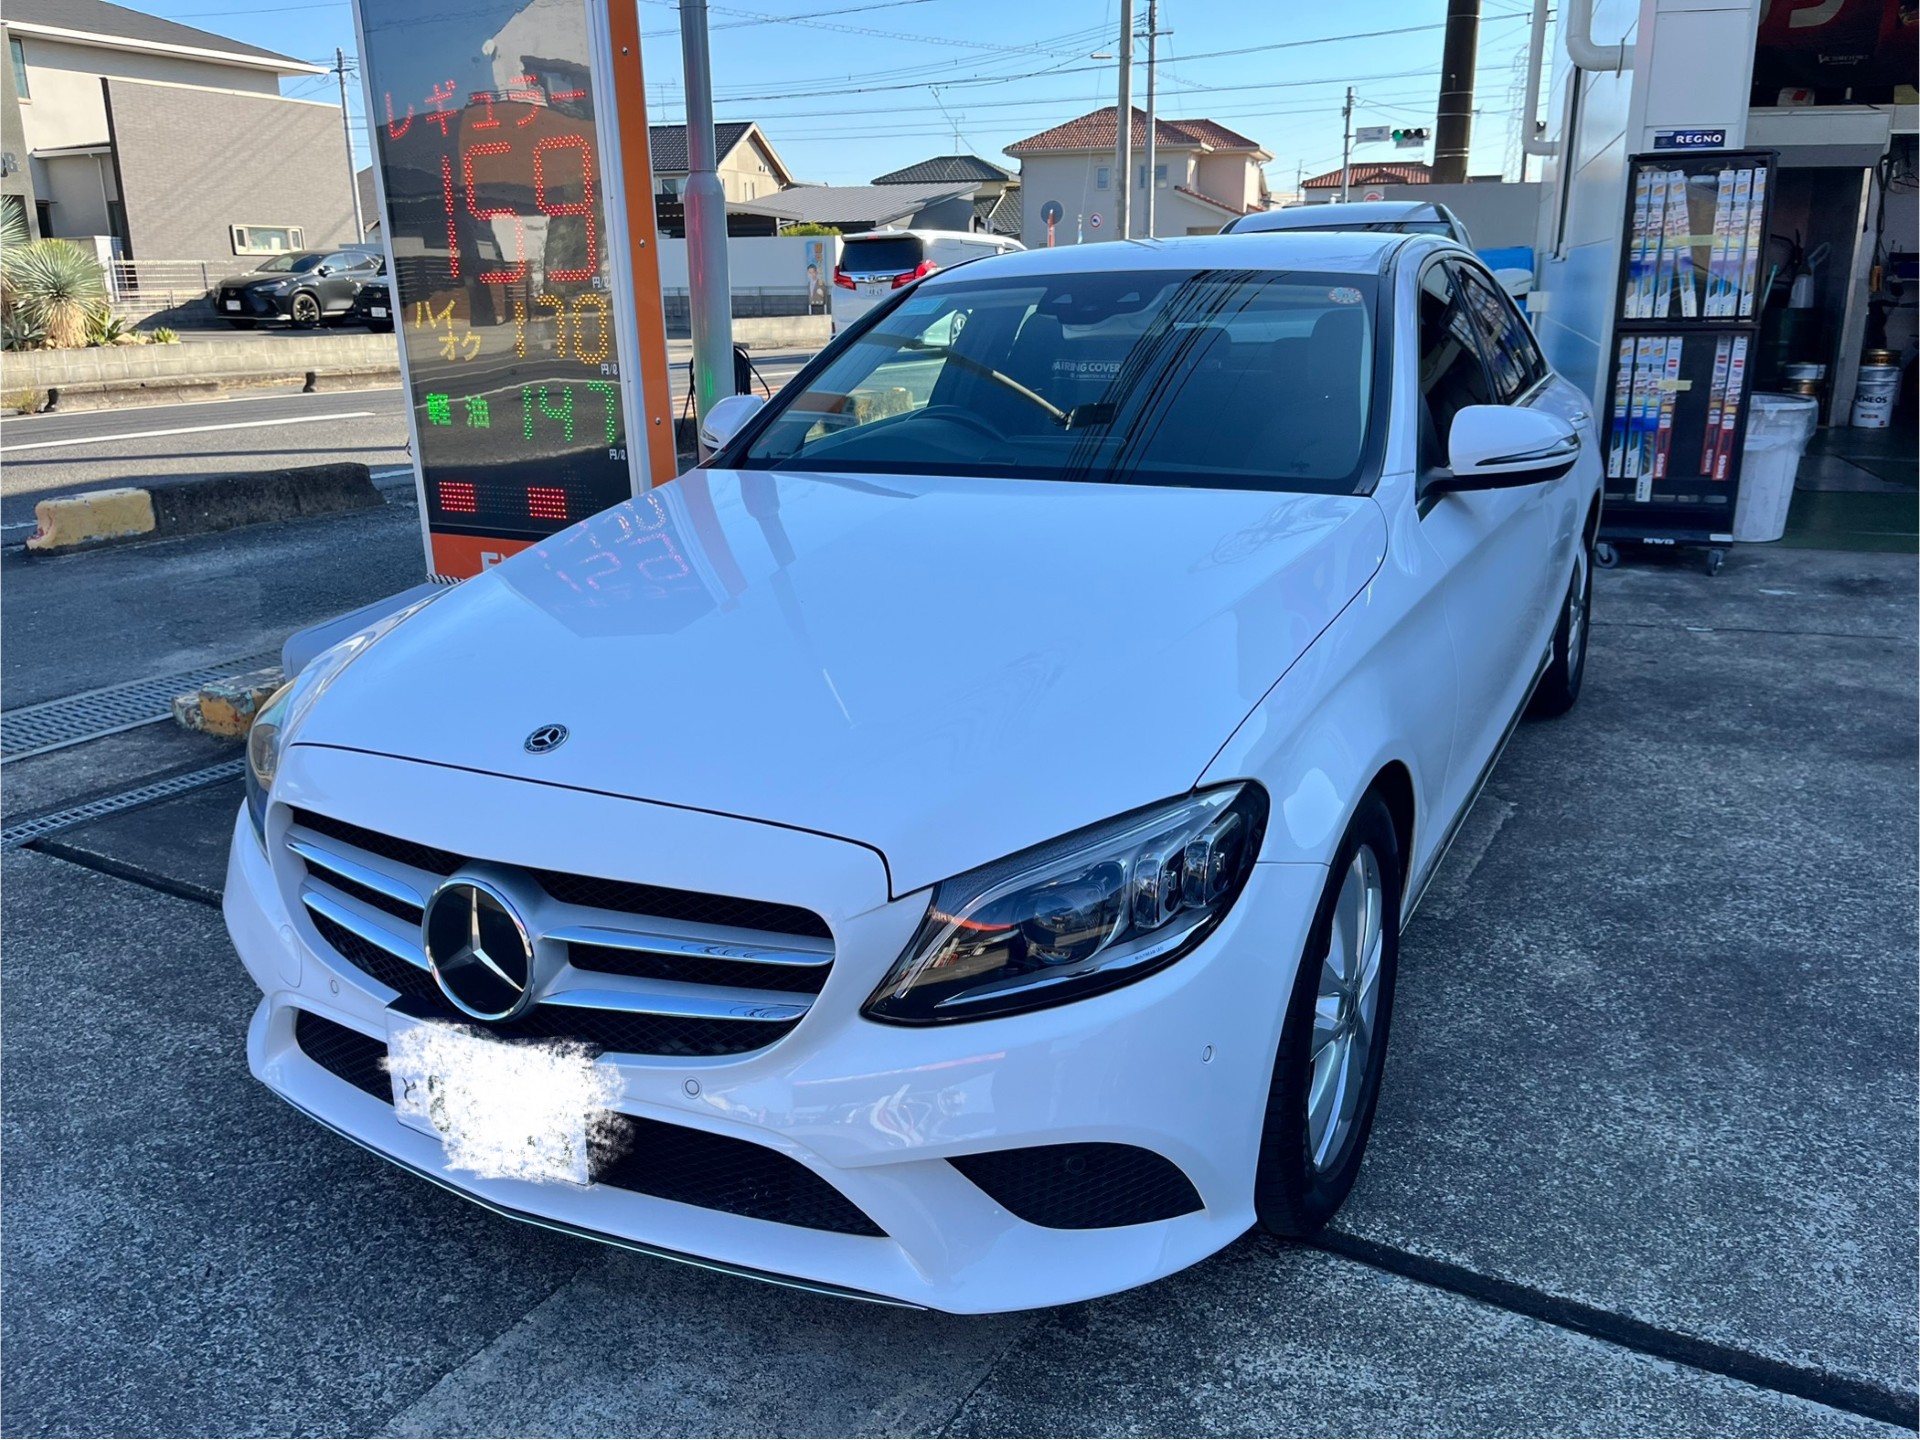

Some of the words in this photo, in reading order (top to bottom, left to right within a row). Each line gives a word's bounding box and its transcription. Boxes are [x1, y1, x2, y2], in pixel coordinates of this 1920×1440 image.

[385, 74, 586, 139] レギュラー
[1675, 134, 1722, 144] REGNO
[441, 133, 597, 284] 159
[515, 293, 608, 364] 170
[1088, 362, 1120, 373] COVER
[522, 380, 615, 443] 147
[1858, 395, 1888, 404] ENEOS
